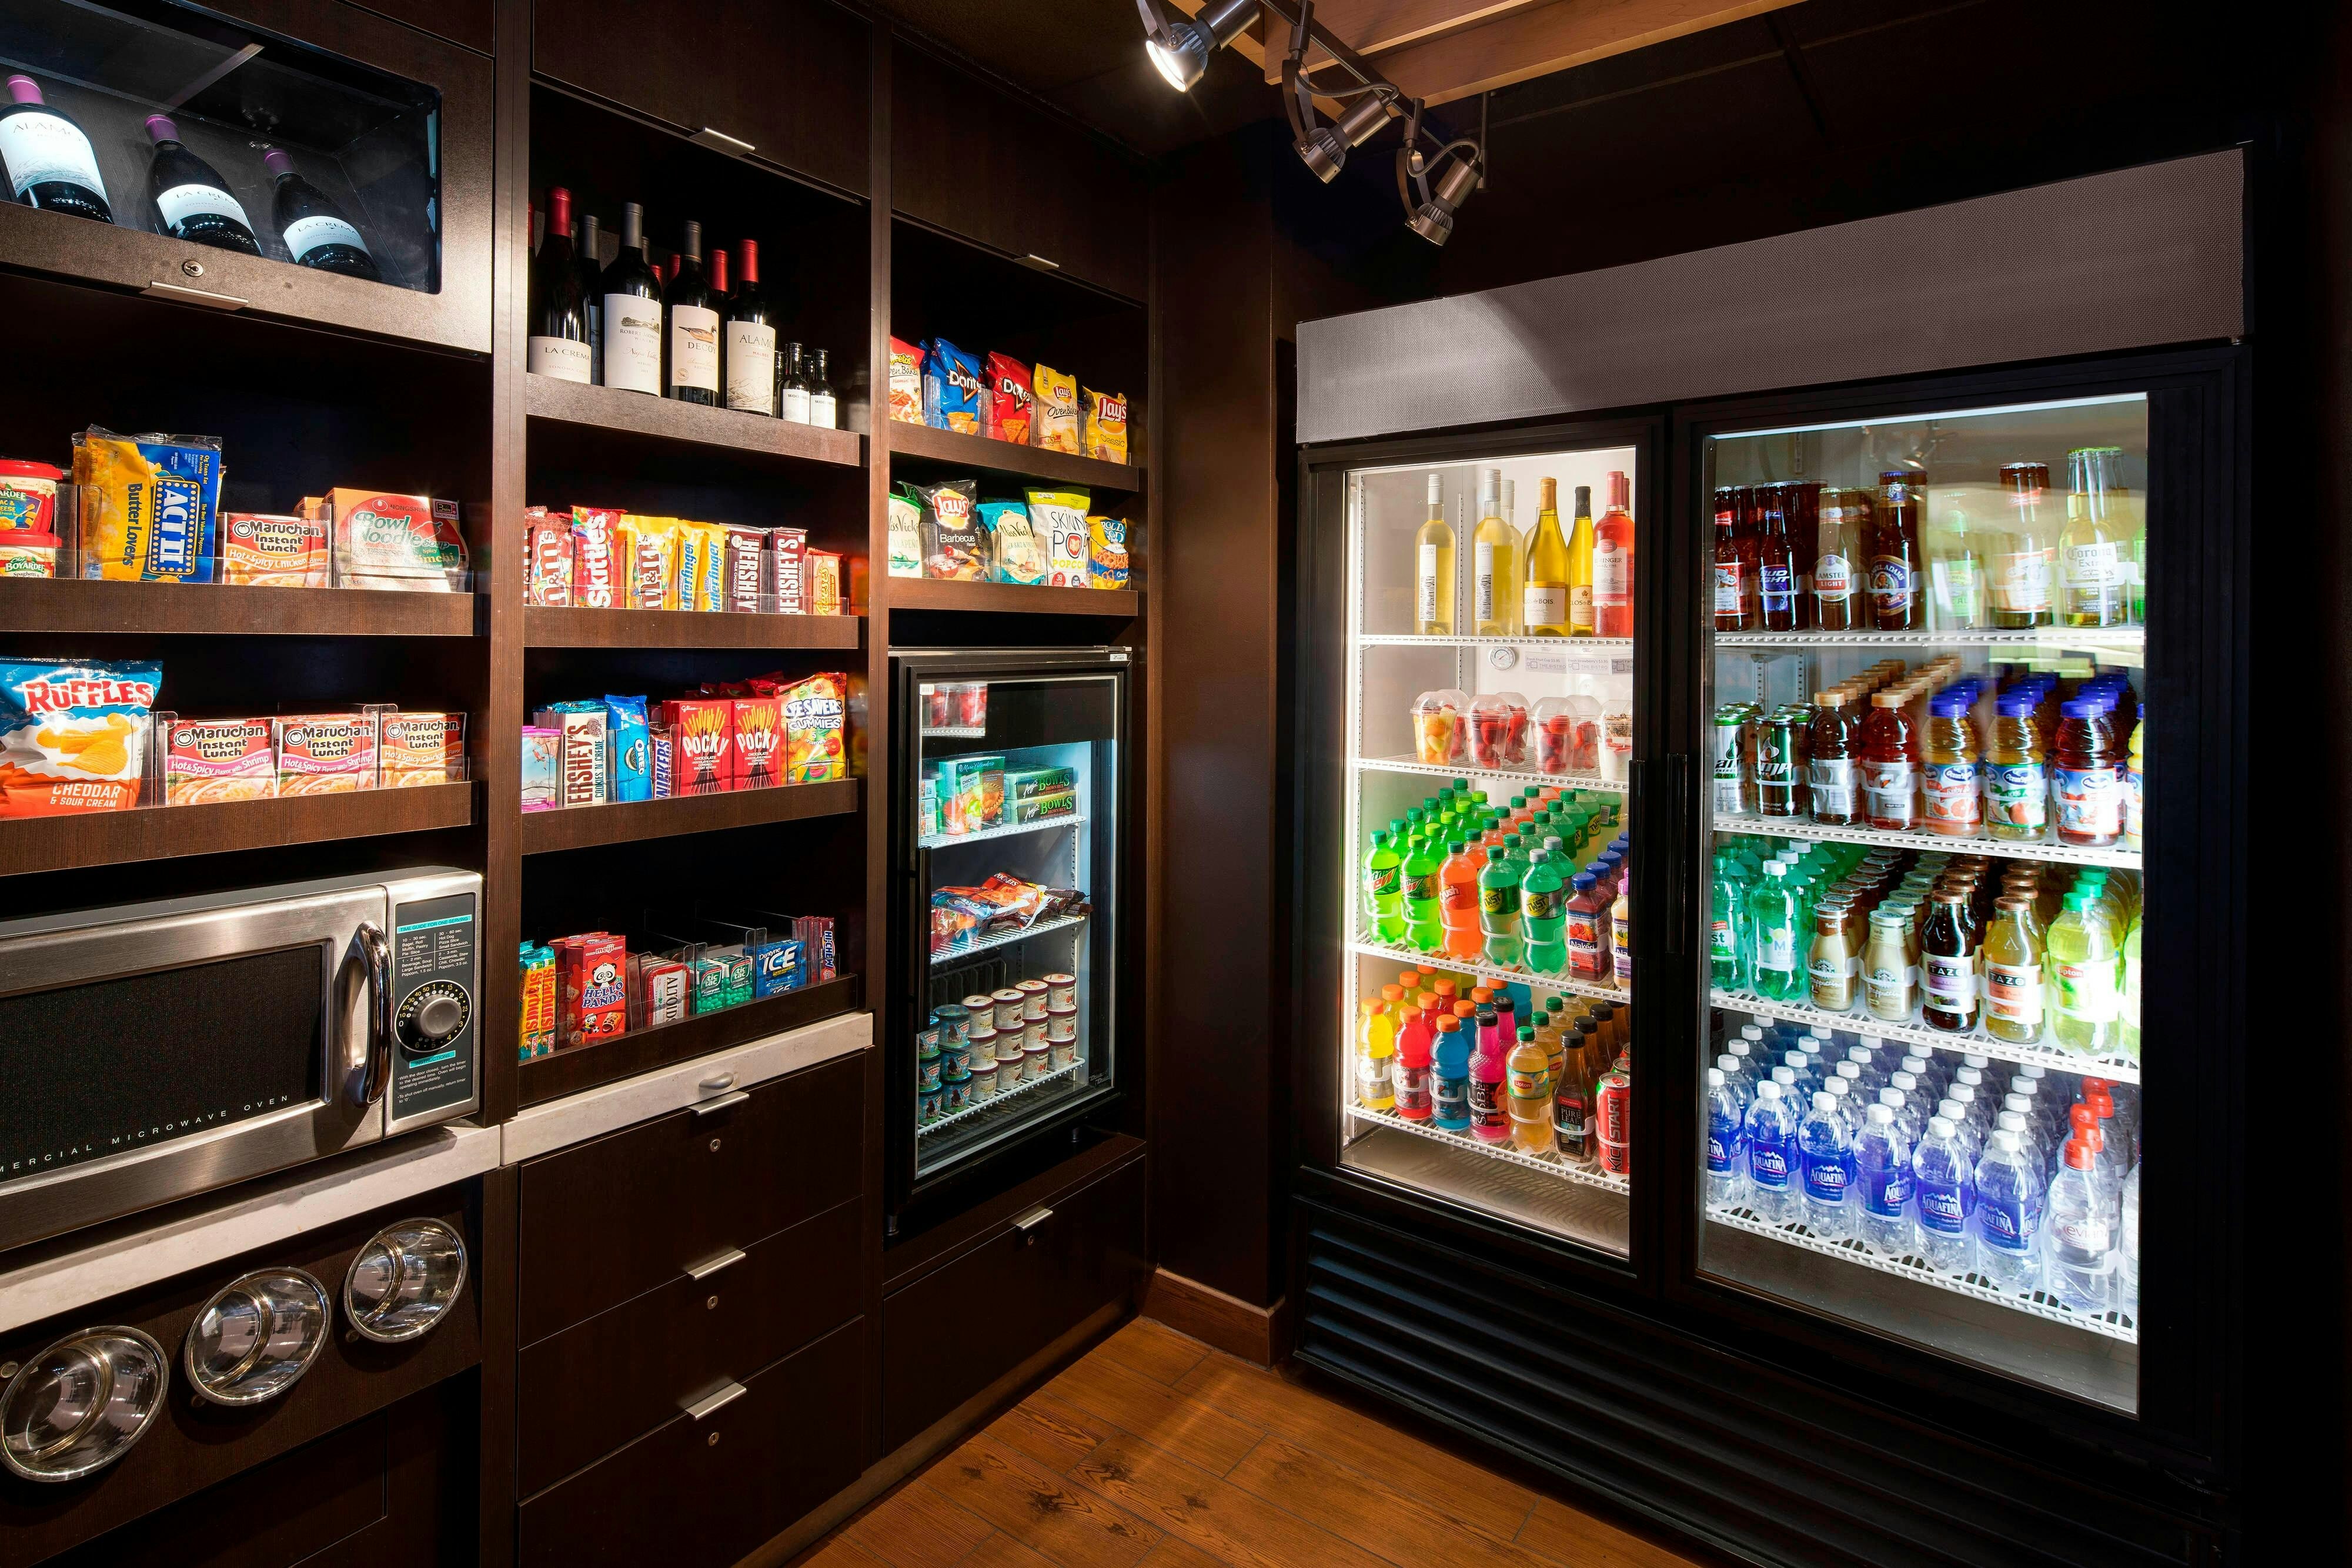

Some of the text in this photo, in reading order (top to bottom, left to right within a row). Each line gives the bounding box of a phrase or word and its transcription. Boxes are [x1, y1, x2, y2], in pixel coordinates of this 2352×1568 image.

[298, 224, 312, 232] LA
[688, 342, 716, 353] DECOY
[562, 349, 590, 361] CREMA
[1100, 399, 1126, 420] Lay's
[1100, 434, 1125, 447] Classic
[390, 504, 427, 513] NONGSHIM
[939, 496, 970, 517] Lay's
[122, 483, 143, 566] Butter Lovers
[160, 489, 188, 563] ACT II
[355, 512, 410, 531] Bowl
[250, 521, 321, 536] Maruchan
[255, 534, 303, 545] Instant
[940, 533, 975, 544] Barbecue
[260, 543, 298, 553] Lunch
[583, 512, 612, 608] Skittles
[5, 562, 45, 573] BOYARDEE
[1885, 565, 1905, 581] ADAMS
[25, 680, 153, 713] RUFFLES
[400, 720, 457, 732] Maruchan
[789, 718, 841, 730] GUMMIES
[191, 726, 264, 739] Maruchan
[303, 726, 369, 738] Maruchan
[405, 733, 443, 741] Instant
[198, 739, 247, 750] Instant
[308, 739, 353, 749] Instant
[410, 740, 440, 748] Lunch
[203, 748, 242, 758] Lunch
[312, 748, 348, 757] Lunch
[634, 738, 645, 775] OREO
[242, 755, 269, 768] Shrimp
[347, 754, 372, 767] Shrimp
[594, 740, 604, 798] COOKIES CREME
[962, 776, 977, 785] CHICKEN
[1023, 774, 1070, 798] Amy's BOWLS
[52, 783, 121, 798] CHEDDAR
[60, 797, 82, 806] SOUR
[86, 799, 117, 808] CREAM
[1024, 797, 1073, 822] Amy's BOWLS
[595, 944, 615, 954] meiji
[824, 931, 835, 968] HI-CHEW
[1571, 941, 1595, 950] Naked
[759, 947, 781, 961] Dentyne
[763, 945, 798, 975] ICE
[1990, 972, 2025, 985] TAZO
[583, 981, 623, 999] HELLO
[582, 991, 625, 1008] PANDA
[415, 1054, 450, 1065] INSTRUCTIONS
[1550, 1062, 1562, 1071] Lipton
[1561, 1108, 1581, 1118] PURE
[112, 1095, 288, 1145] MICROWAVE OVEN
[1561, 1115, 1580, 1125] LEAF
[1810, 1169, 1847, 1186] AQUAFINA
[1922, 1195, 1963, 1218] AQUAFINA
